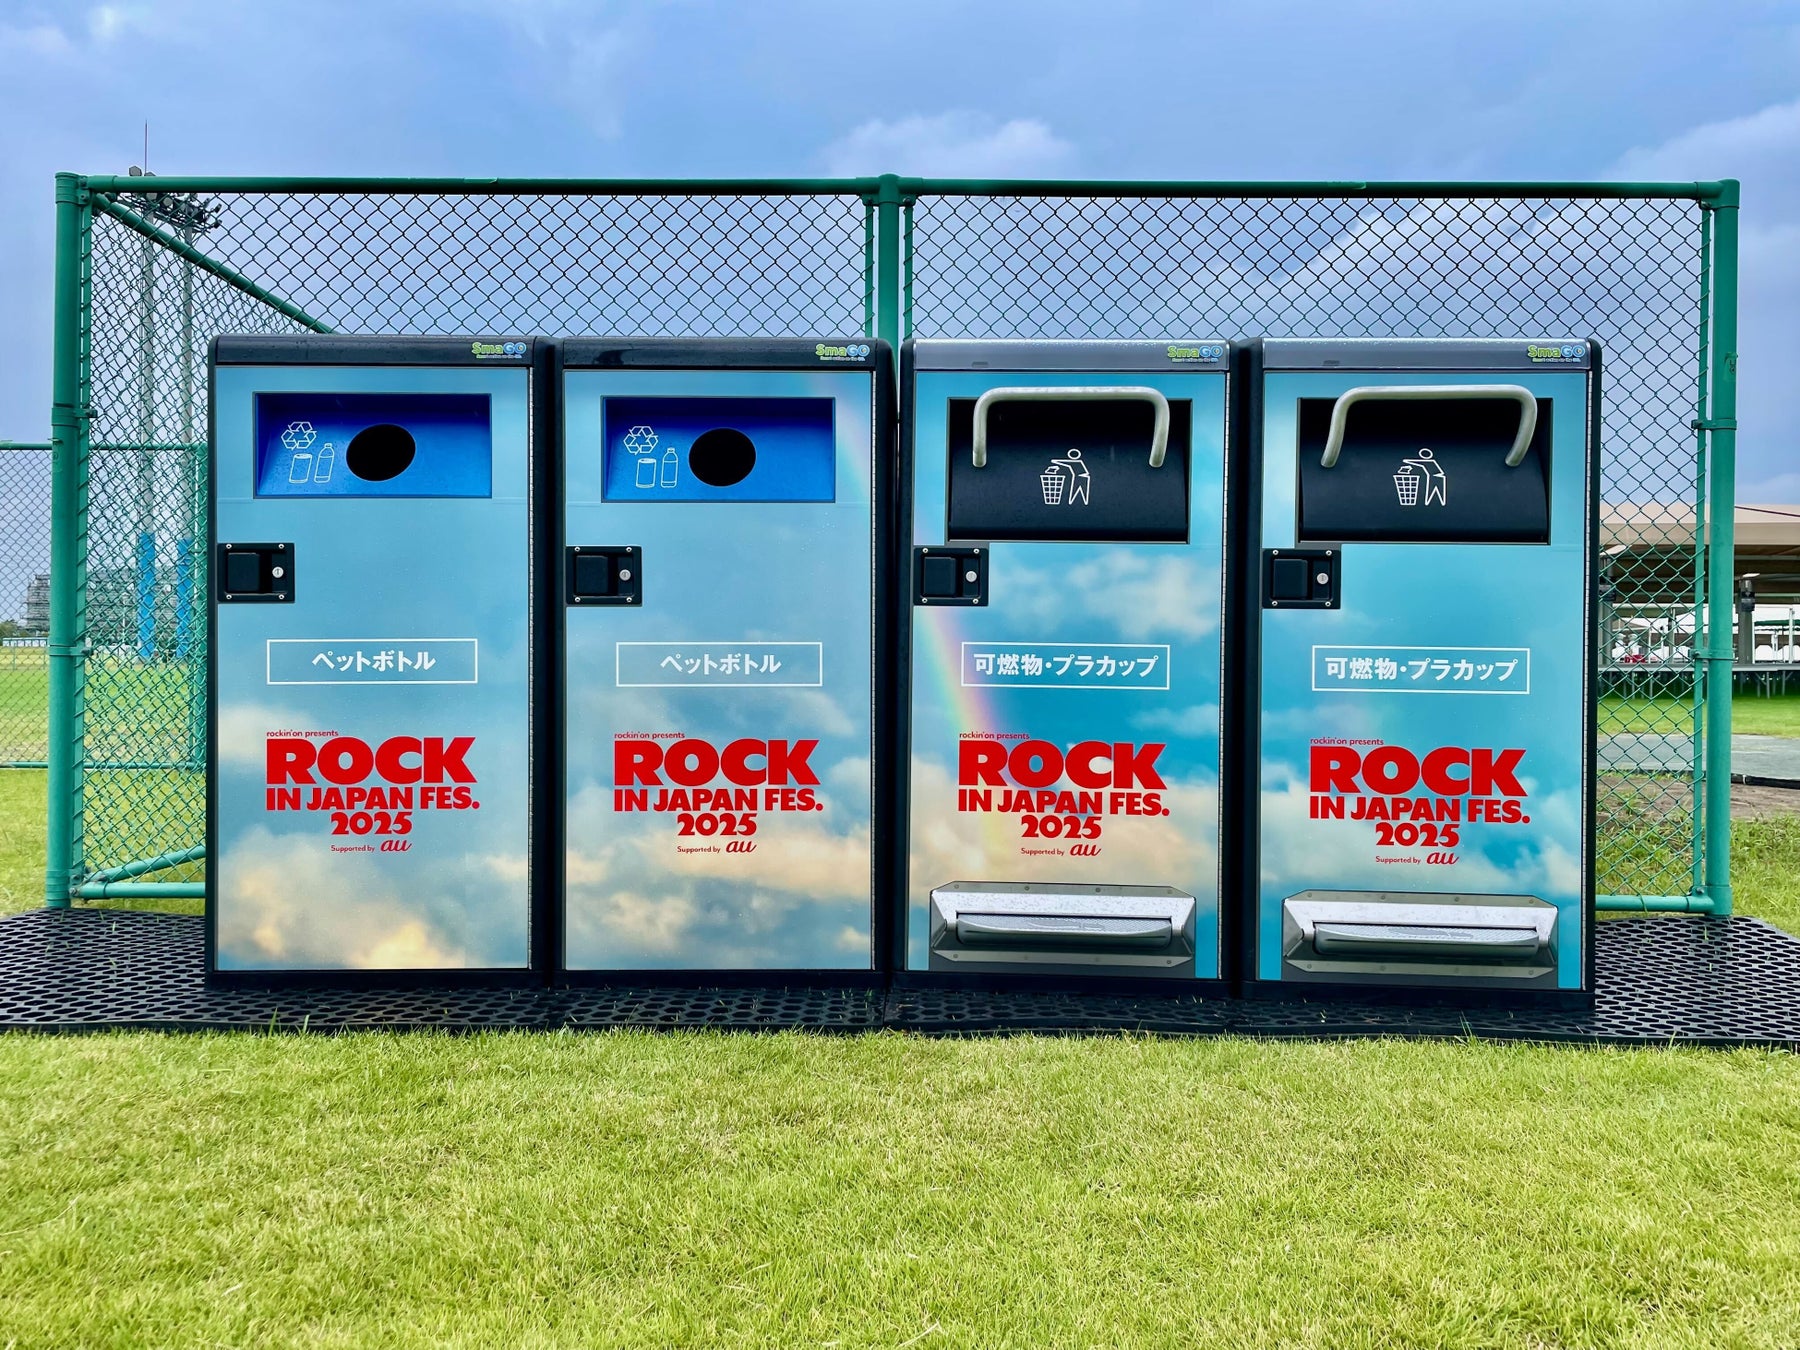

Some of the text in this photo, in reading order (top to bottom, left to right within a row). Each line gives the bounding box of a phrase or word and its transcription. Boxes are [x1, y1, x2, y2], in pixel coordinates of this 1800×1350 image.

[472, 342, 526, 354] SmaGO
[816, 344, 870, 356] SmaGO
[1167, 346, 1223, 358] SmaGO
[1527, 345, 1585, 358] SmaGO
[312, 650, 436, 672] ペットボトル
[660, 653, 782, 675] ペットボトル
[973, 653, 1159, 678] 可燃物・プラカップ
[1325, 657, 1518, 681] 可燃物・プラカップ
[305, 730, 339, 738] presents
[652, 732, 685, 740] presents
[1349, 738, 1384, 746] presents
[266, 736, 477, 785] ROCK
[614, 738, 821, 787] ROCK
[958, 739, 1168, 790] ROCK
[1310, 746, 1528, 797] ROCK
[266, 786, 480, 810] IN JAPAN FES.
[614, 788, 823, 811] IN JAPAN FES.
[958, 789, 1170, 816] IN JAPAN FES.
[1310, 796, 1530, 823] IN JAPAN FES.
[331, 812, 412, 835] 2025
[677, 813, 757, 836] 2025
[1021, 815, 1101, 839] 2025
[1375, 822, 1460, 847] 2025
[331, 839, 412, 853] Supported by au
[677, 840, 757, 854] Supported by au
[1021, 843, 1101, 857] Supported by au
[1375, 851, 1459, 866] Supported by au
